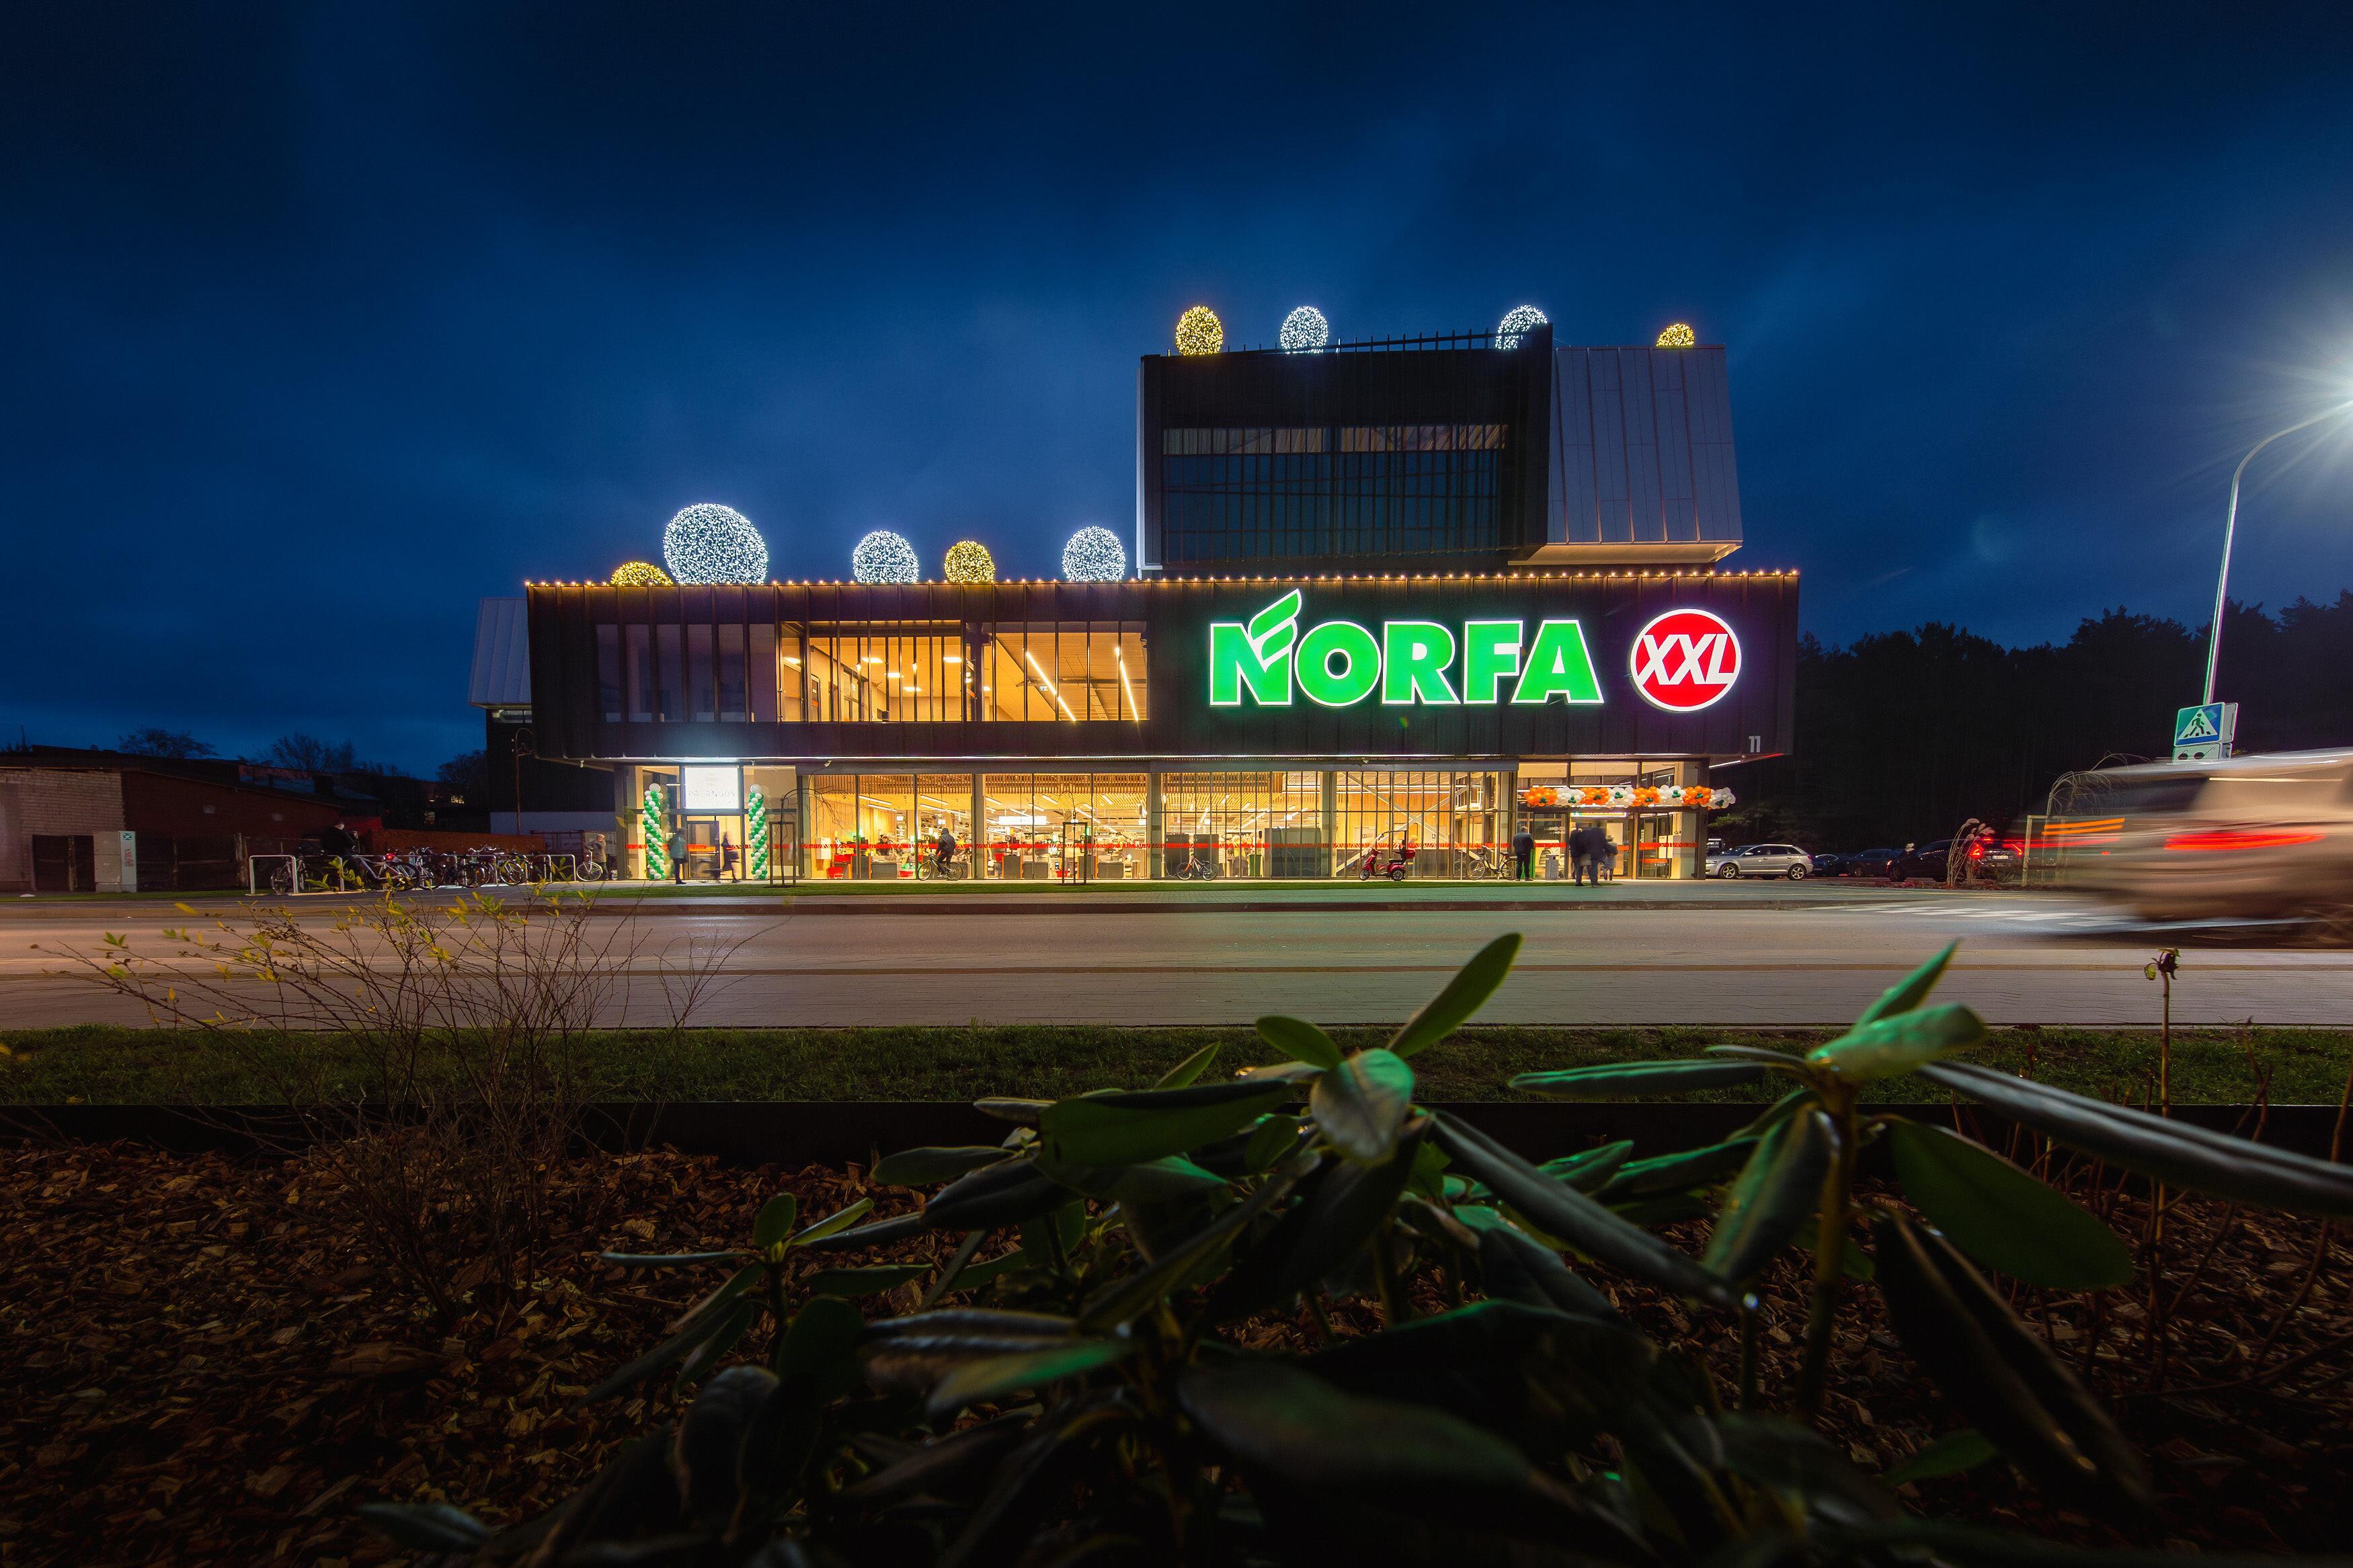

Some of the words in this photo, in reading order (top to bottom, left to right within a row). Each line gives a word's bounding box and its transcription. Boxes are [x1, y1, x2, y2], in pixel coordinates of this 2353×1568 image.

[1209, 589, 1605, 706] NORFA
[1636, 634, 1736, 685] XXL
[1749, 736, 1761, 753] 11
